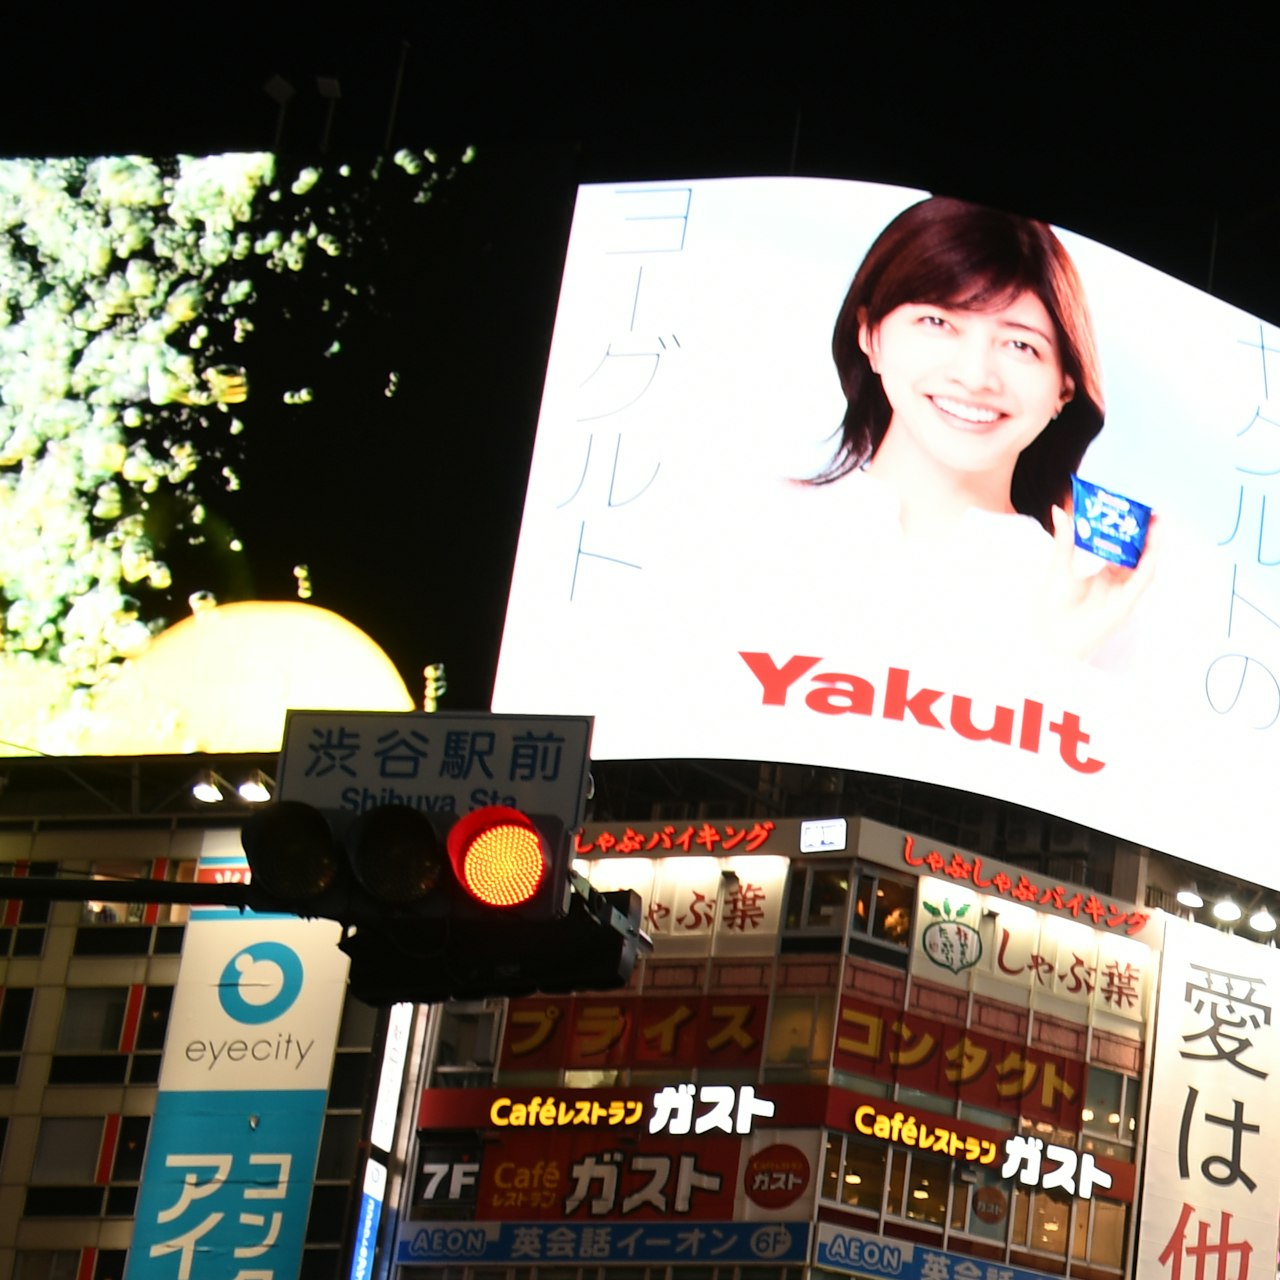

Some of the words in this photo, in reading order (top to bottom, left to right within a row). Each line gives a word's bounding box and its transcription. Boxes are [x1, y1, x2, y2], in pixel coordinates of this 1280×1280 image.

[556, 188, 692, 602] ヨーグルト
[737, 651, 1107, 775] Yakult
[305, 728, 566, 783] 渋谷駅前
[642, 884, 766, 931] ゃぶ葉
[904, 836, 1149, 935] しゃぶしゃぶバイキング
[998, 928, 1140, 1009] しゃぶ葉
[185, 1034, 315, 1071] eyecity
[508, 1004, 757, 1057] プライス
[837, 1008, 1075, 1109] コンタクト
[490, 1095, 643, 1126] Caféレストラン
[648, 1083, 775, 1135] ガスト
[494, 1160, 560, 1190] Café
[854, 1104, 997, 1165] Caféレストラン
[1001, 1135, 1113, 1200] ガスト
[422, 1164, 479, 1199] 7F
[564, 1152, 723, 1216] ガスト
[752, 1172, 803, 1191] ガスト
[410, 1229, 486, 1256] AEON
[511, 1226, 739, 1259] 英会話イーオン
[828, 1234, 902, 1271] AEON
